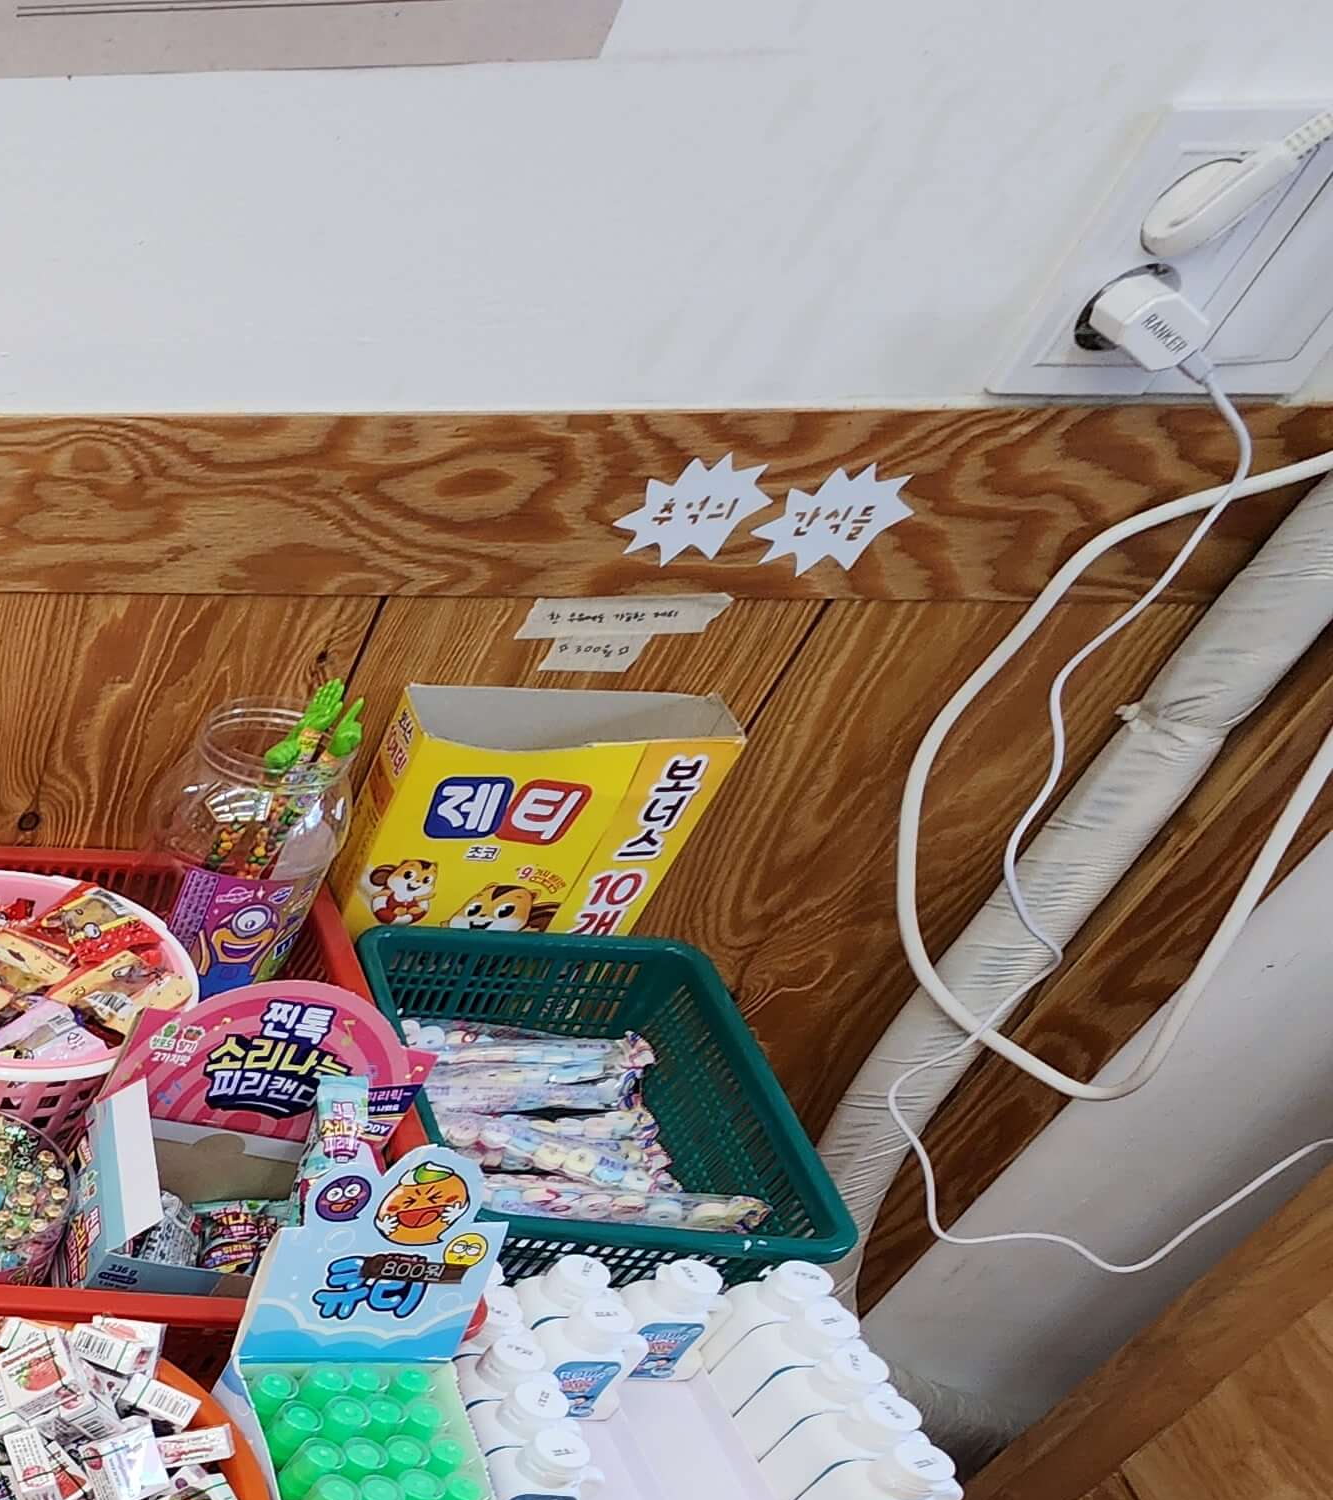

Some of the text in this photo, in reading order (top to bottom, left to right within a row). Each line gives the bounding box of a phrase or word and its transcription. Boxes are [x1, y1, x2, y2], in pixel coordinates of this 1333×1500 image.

[651, 495, 877, 542] 추억의 간식들
[436, 782, 583, 842] 제티
[614, 753, 709, 862] 보너스
[465, 845, 499, 861] 초코
[588, 869, 644, 907] 10
[263, 1001, 336, 1044] 찐톡
[206, 1035, 352, 1079] 소리나는
[378, 1261, 447, 1284] 800원
